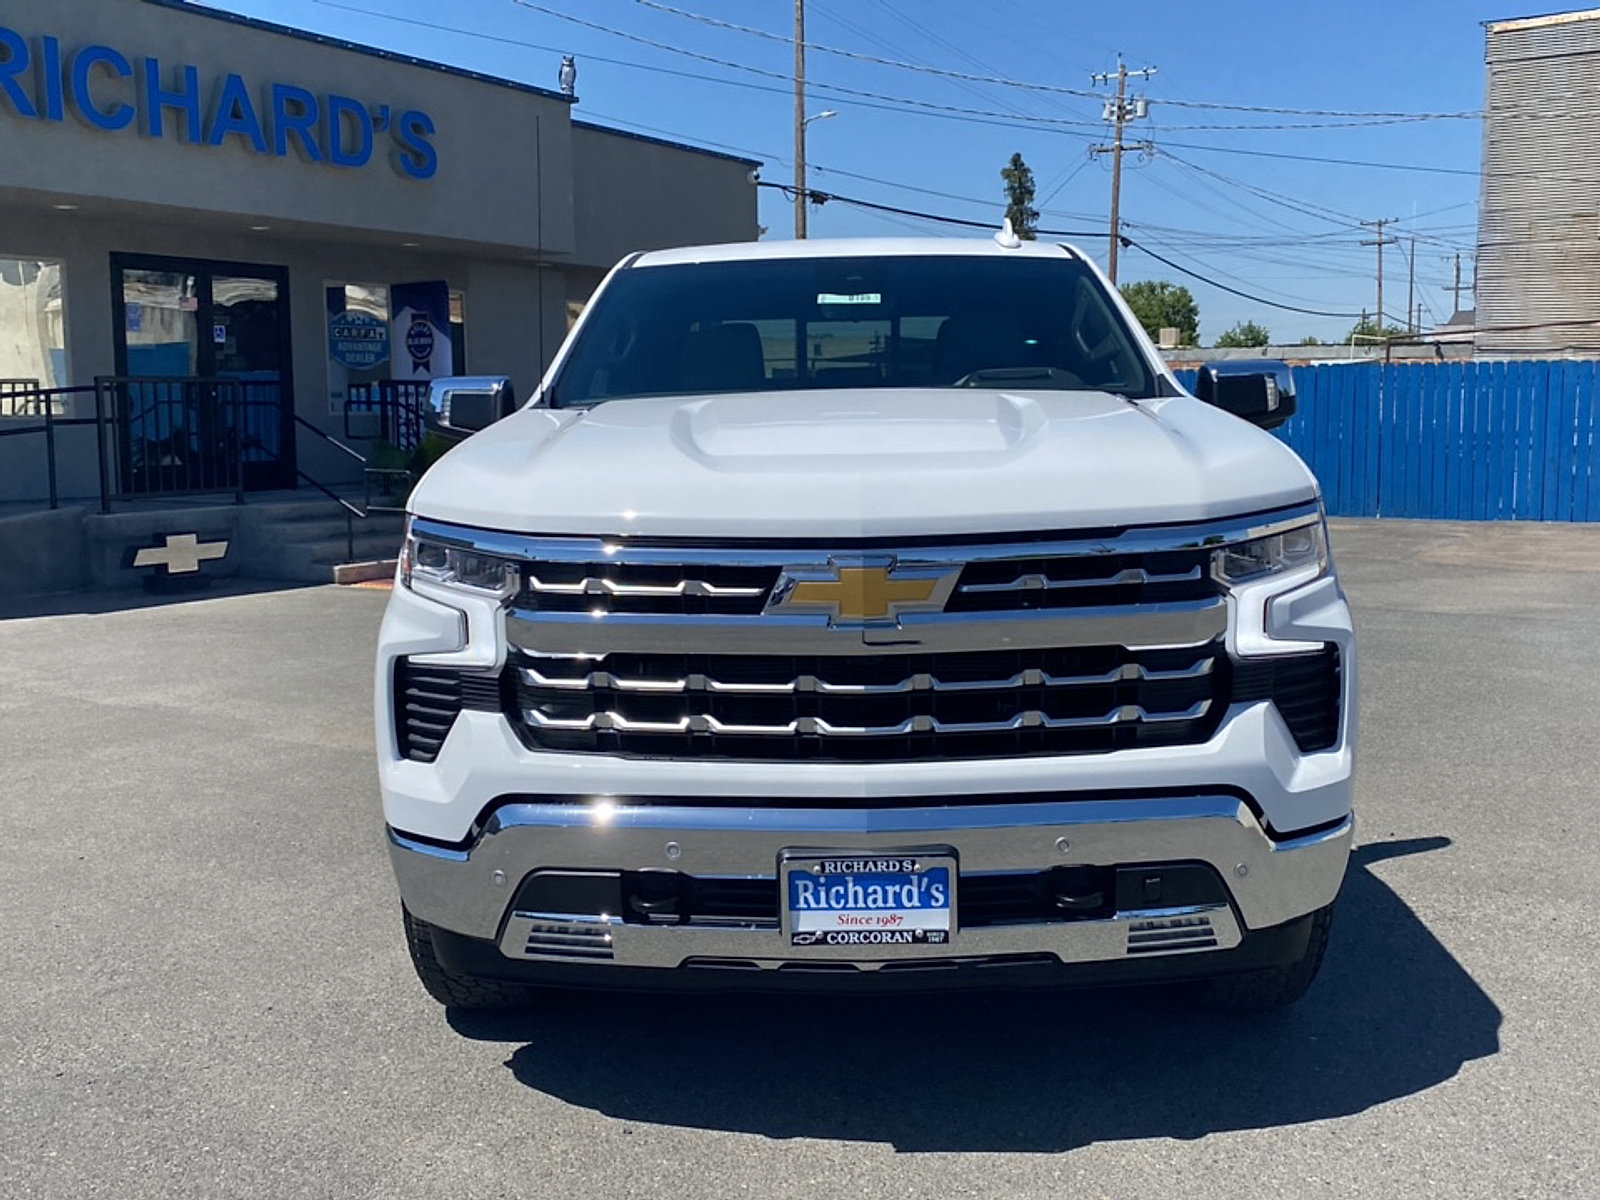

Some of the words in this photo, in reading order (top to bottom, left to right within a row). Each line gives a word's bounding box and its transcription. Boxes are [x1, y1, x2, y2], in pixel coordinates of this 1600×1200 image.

[0, 27, 438, 180] RICHARD'S
[795, 875, 945, 909] Richard's
[837, 914, 873, 926] Since
[876, 914, 904, 926] 1987
[826, 932, 913, 944] CORCORAN
